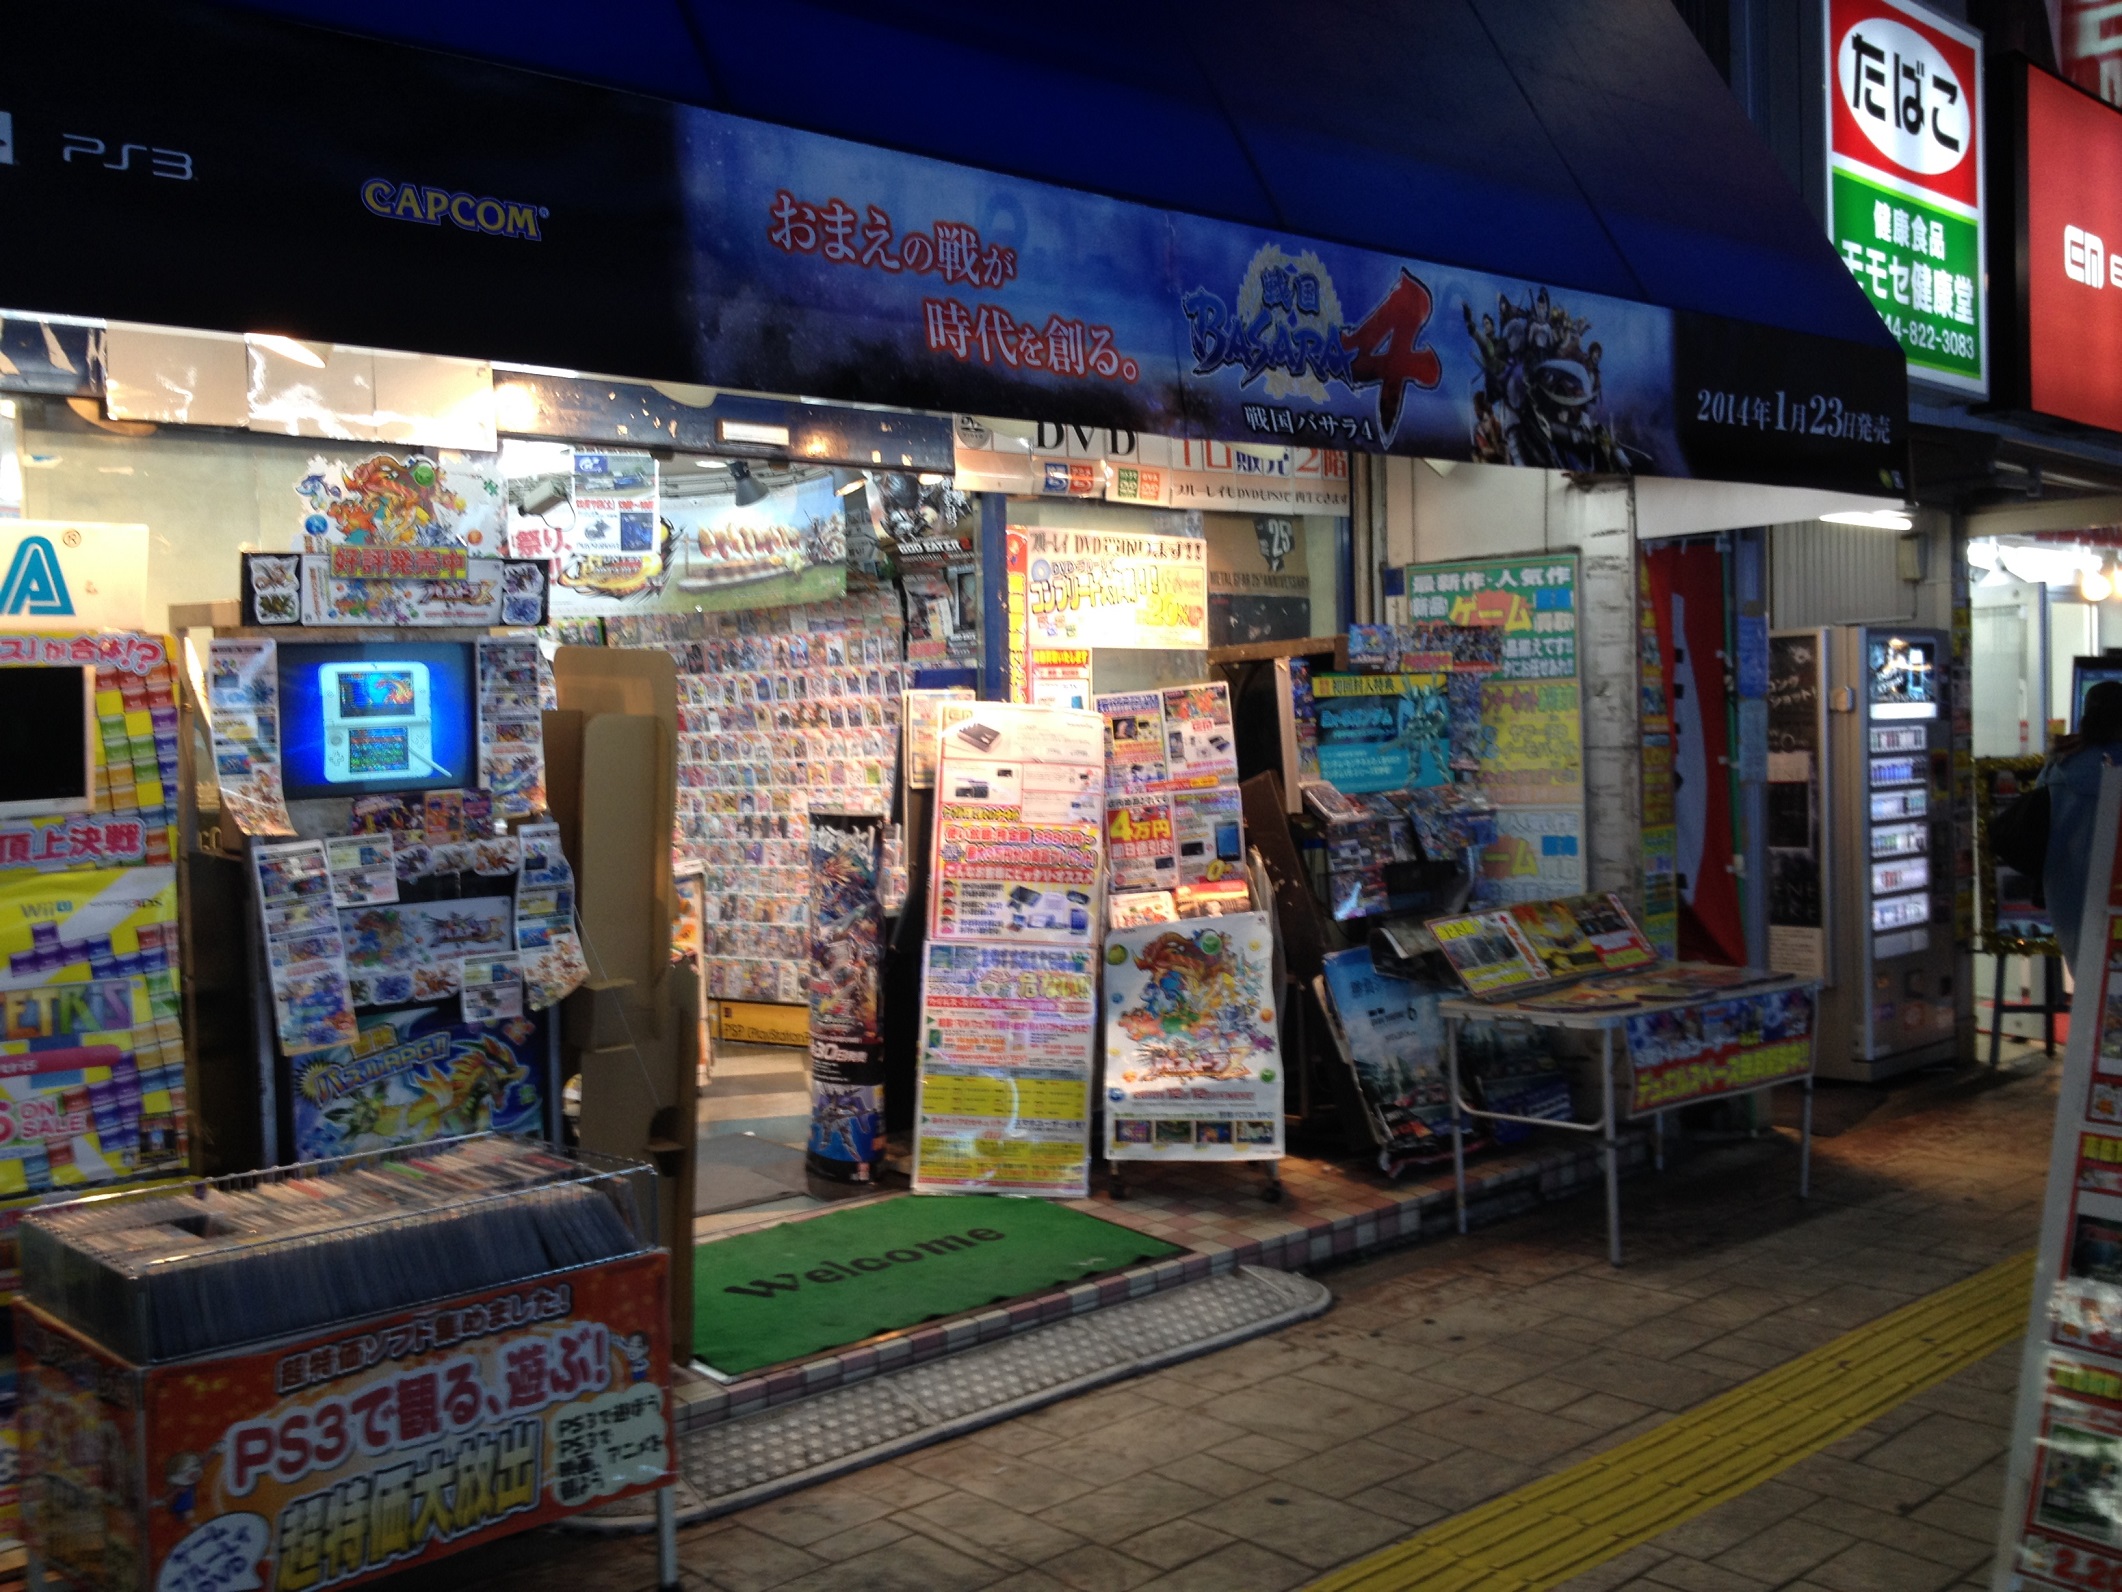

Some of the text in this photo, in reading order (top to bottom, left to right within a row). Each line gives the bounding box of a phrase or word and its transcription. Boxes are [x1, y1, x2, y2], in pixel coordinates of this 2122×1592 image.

[1851, 33, 1960, 153] たばこ
[62, 132, 195, 181] PS3
[361, 177, 544, 242] CAPCOM
[1873, 198, 1945, 260] 健康食品
[771, 190, 1018, 290] おまえの戦が
[1841, 240, 1975, 325] モモセ健康堂
[924, 299, 1140, 383] 時代を創る。
[1183, 267, 1441, 449] BASARA 4
[1244, 403, 1374, 440] 戦国バサラ4
[1697, 389, 1891, 444] 2014年1月23日発売
[335, 546, 467, 577] 好評発売中
[1268, 518, 1293, 557] 25
[1412, 565, 1572, 593] 最新作・人気作
[1449, 592, 1533, 632] ゲーム
[1333, 677, 1396, 695] 初回封入特典
[1110, 809, 1172, 842] 4万円
[20, 902, 55, 918] Wii
[0, 982, 131, 1040] ETRIS
[19, 1101, 57, 1119] ON
[21, 1113, 83, 1138] SALE
[724, 1225, 1006, 1299] Welcome
[279, 1284, 571, 1389] 超特価ソフト集めました!
[236, 1328, 605, 1488] PS3で観る、遊ぶ!
[278, 1420, 541, 1592] 超特価大放出
